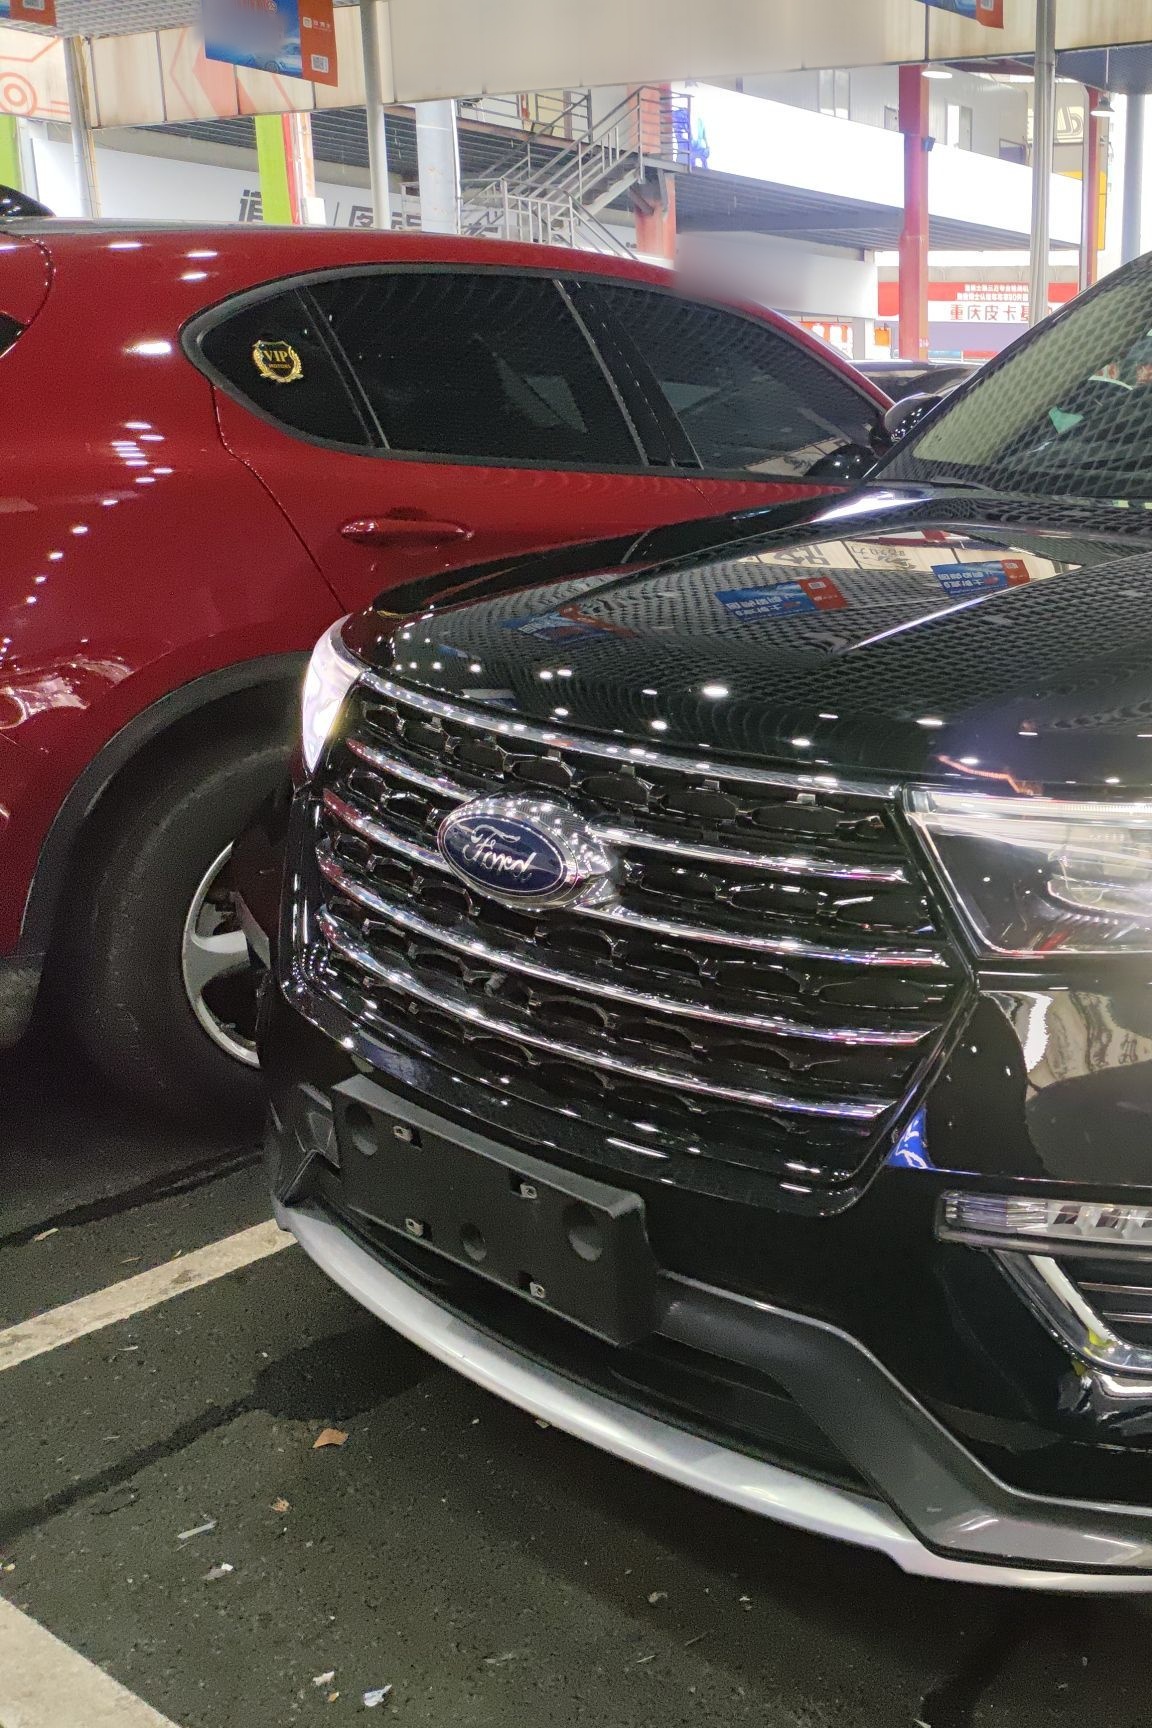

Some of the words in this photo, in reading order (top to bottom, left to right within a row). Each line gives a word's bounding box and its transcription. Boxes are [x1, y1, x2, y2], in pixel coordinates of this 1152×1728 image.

[951, 304, 1052, 321] 重庆皮卡基
[262, 351, 288, 362] VIP
[462, 824, 537, 881] Ford
